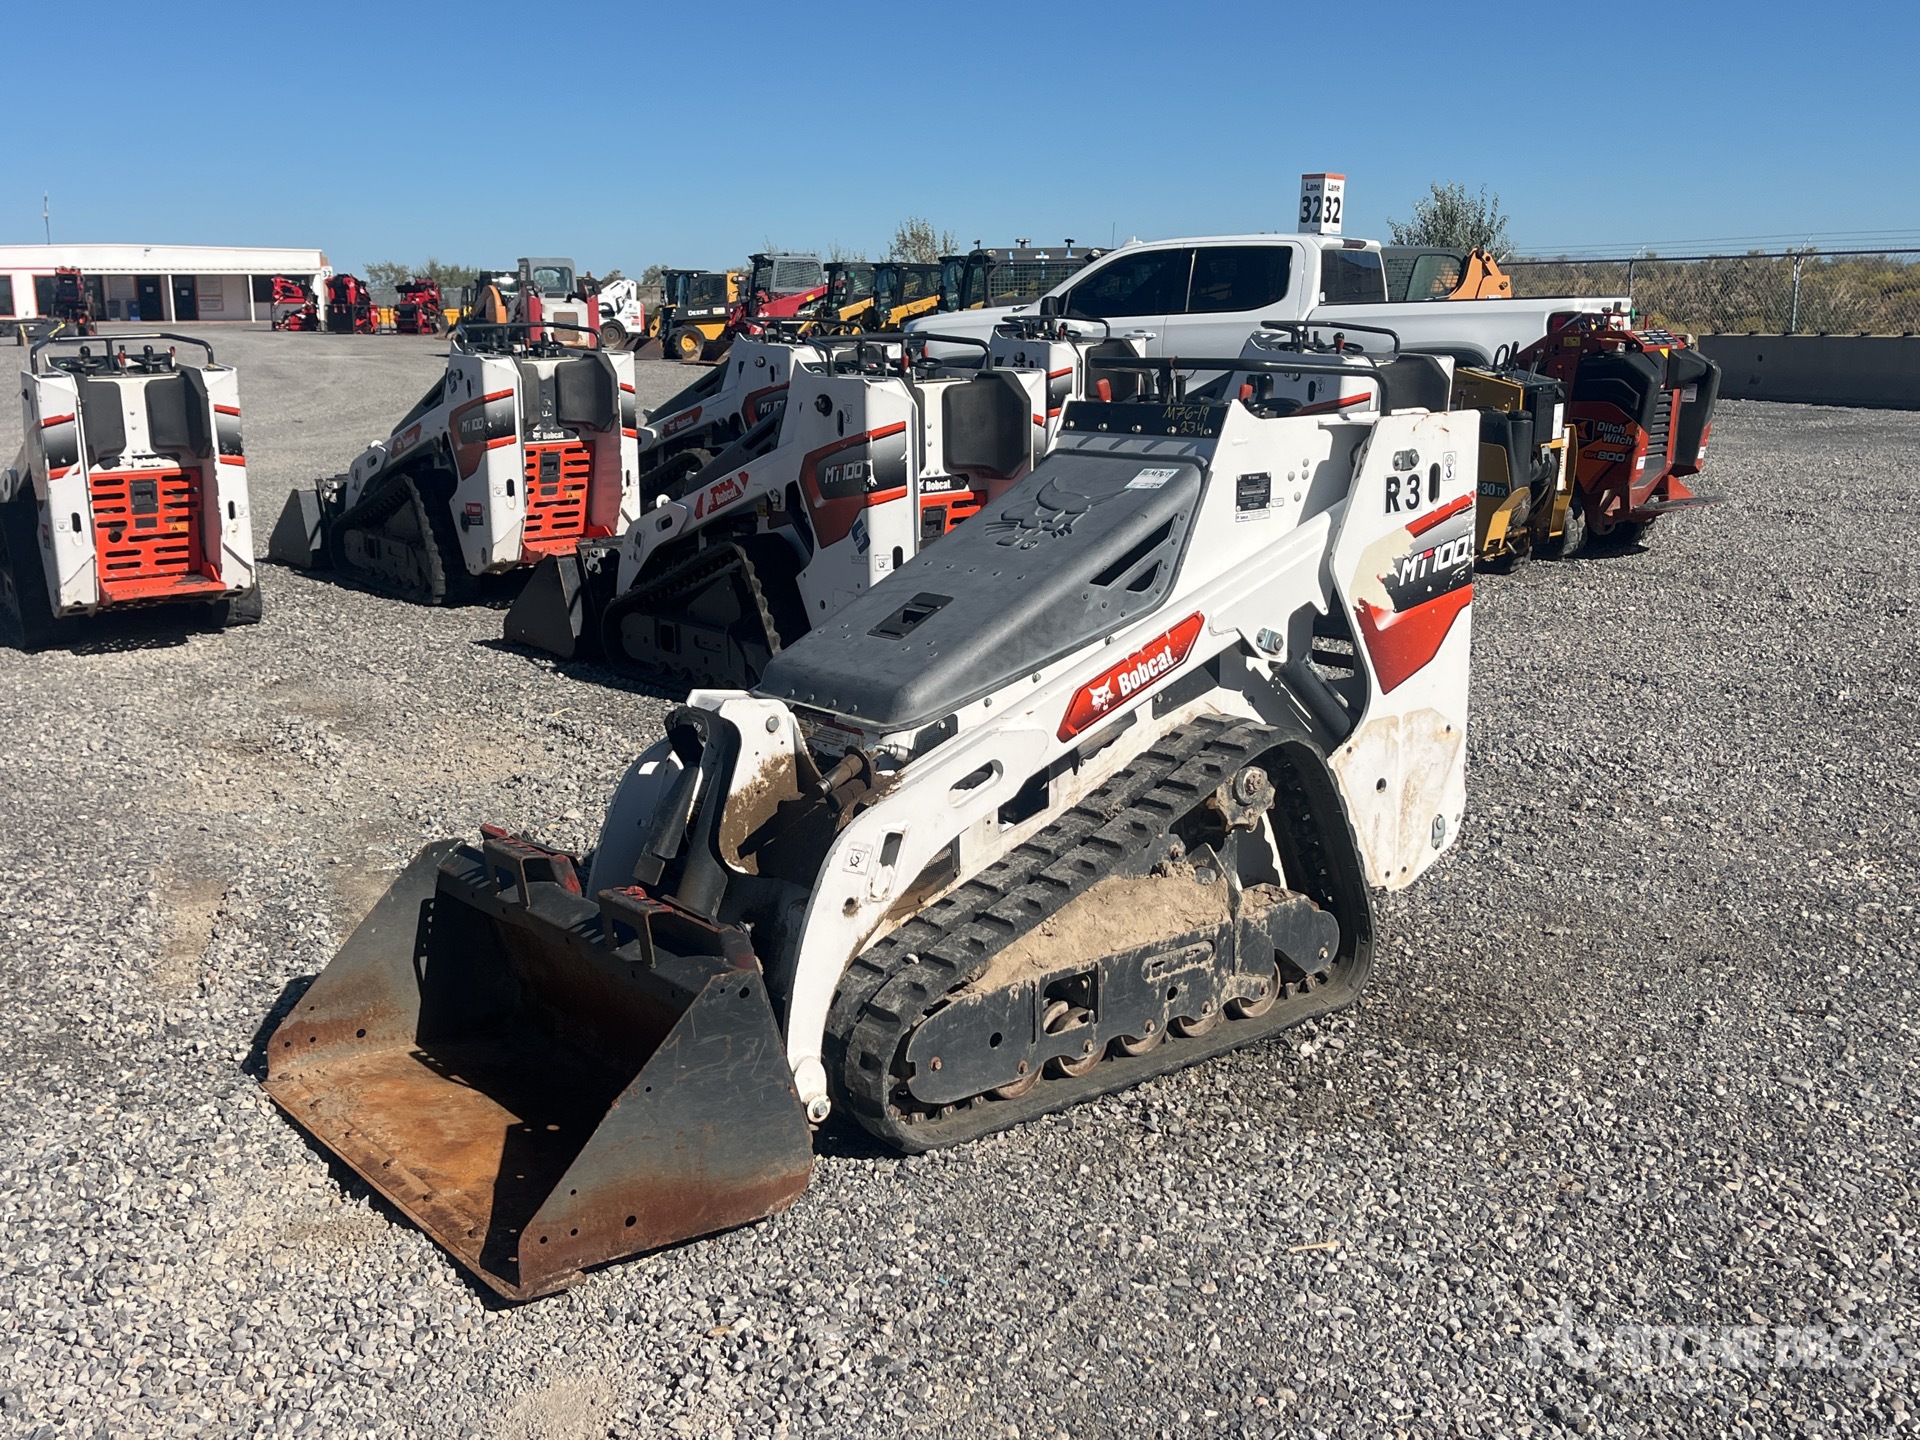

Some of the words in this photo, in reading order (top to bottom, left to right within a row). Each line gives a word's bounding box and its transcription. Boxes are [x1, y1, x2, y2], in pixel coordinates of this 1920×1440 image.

[1305, 182, 1320, 191] Lane
[1327, 182, 1340, 191] Lane
[1300, 196, 1321, 223] 32
[1323, 196, 1340, 223] 32
[1597, 421, 1626, 434] Ditch
[1603, 432, 1633, 446] Witch
[824, 461, 864, 484] MT100
[926, 479, 951, 491] Bobcat
[1497, 486, 1507, 497] TX
[1399, 534, 1471, 586] MT100
[1117, 645, 1175, 698] Bobcat
